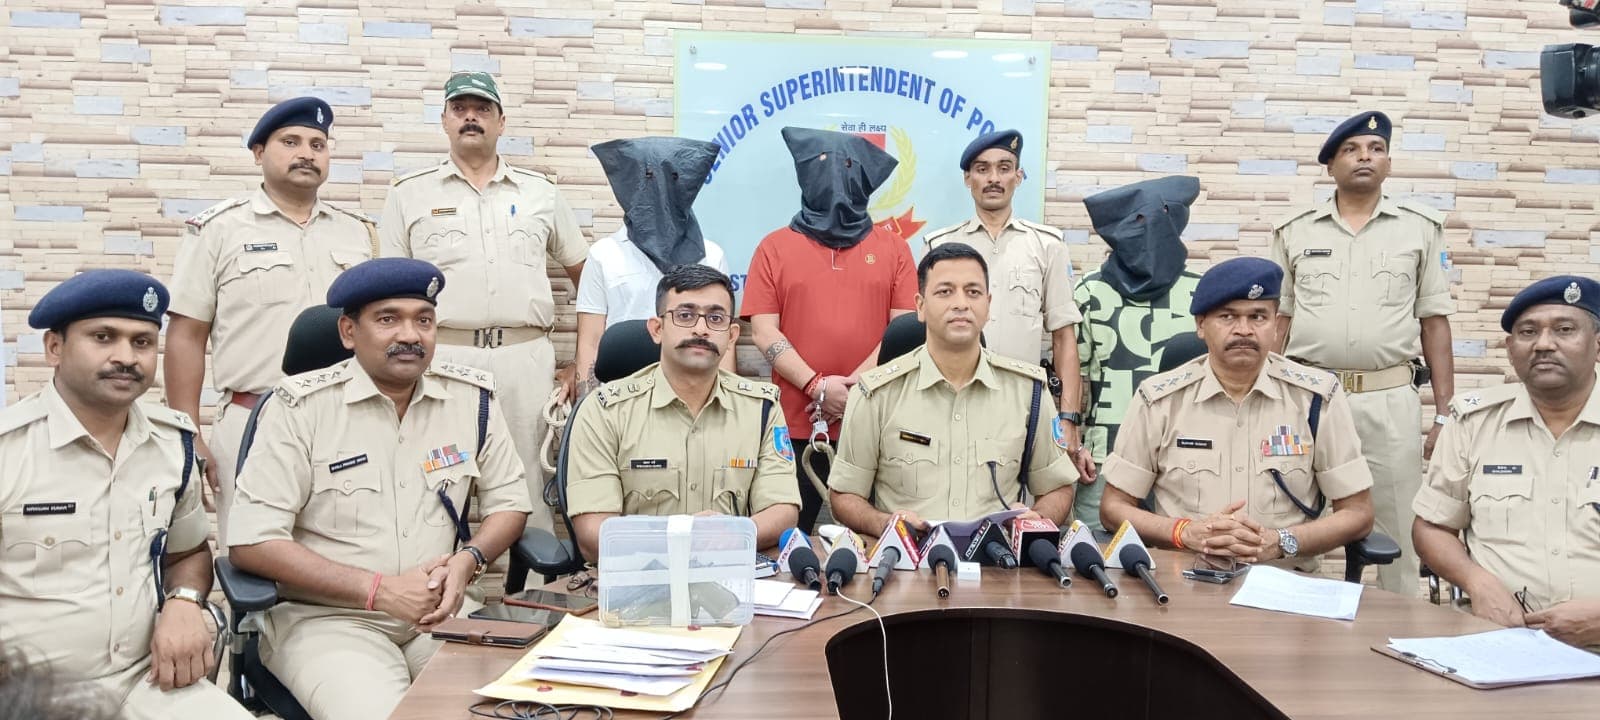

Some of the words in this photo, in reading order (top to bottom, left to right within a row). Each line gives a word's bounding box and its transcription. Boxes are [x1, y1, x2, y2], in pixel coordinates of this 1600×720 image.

[704, 103, 759, 185] NIOR
[760, 66, 936, 118] SUPERINTENDENT
[939, 87, 967, 119] OF
[841, 121, 856, 131] सेवा
[858, 121, 867, 132] ही
[869, 124, 887, 132] लक्ष्य
